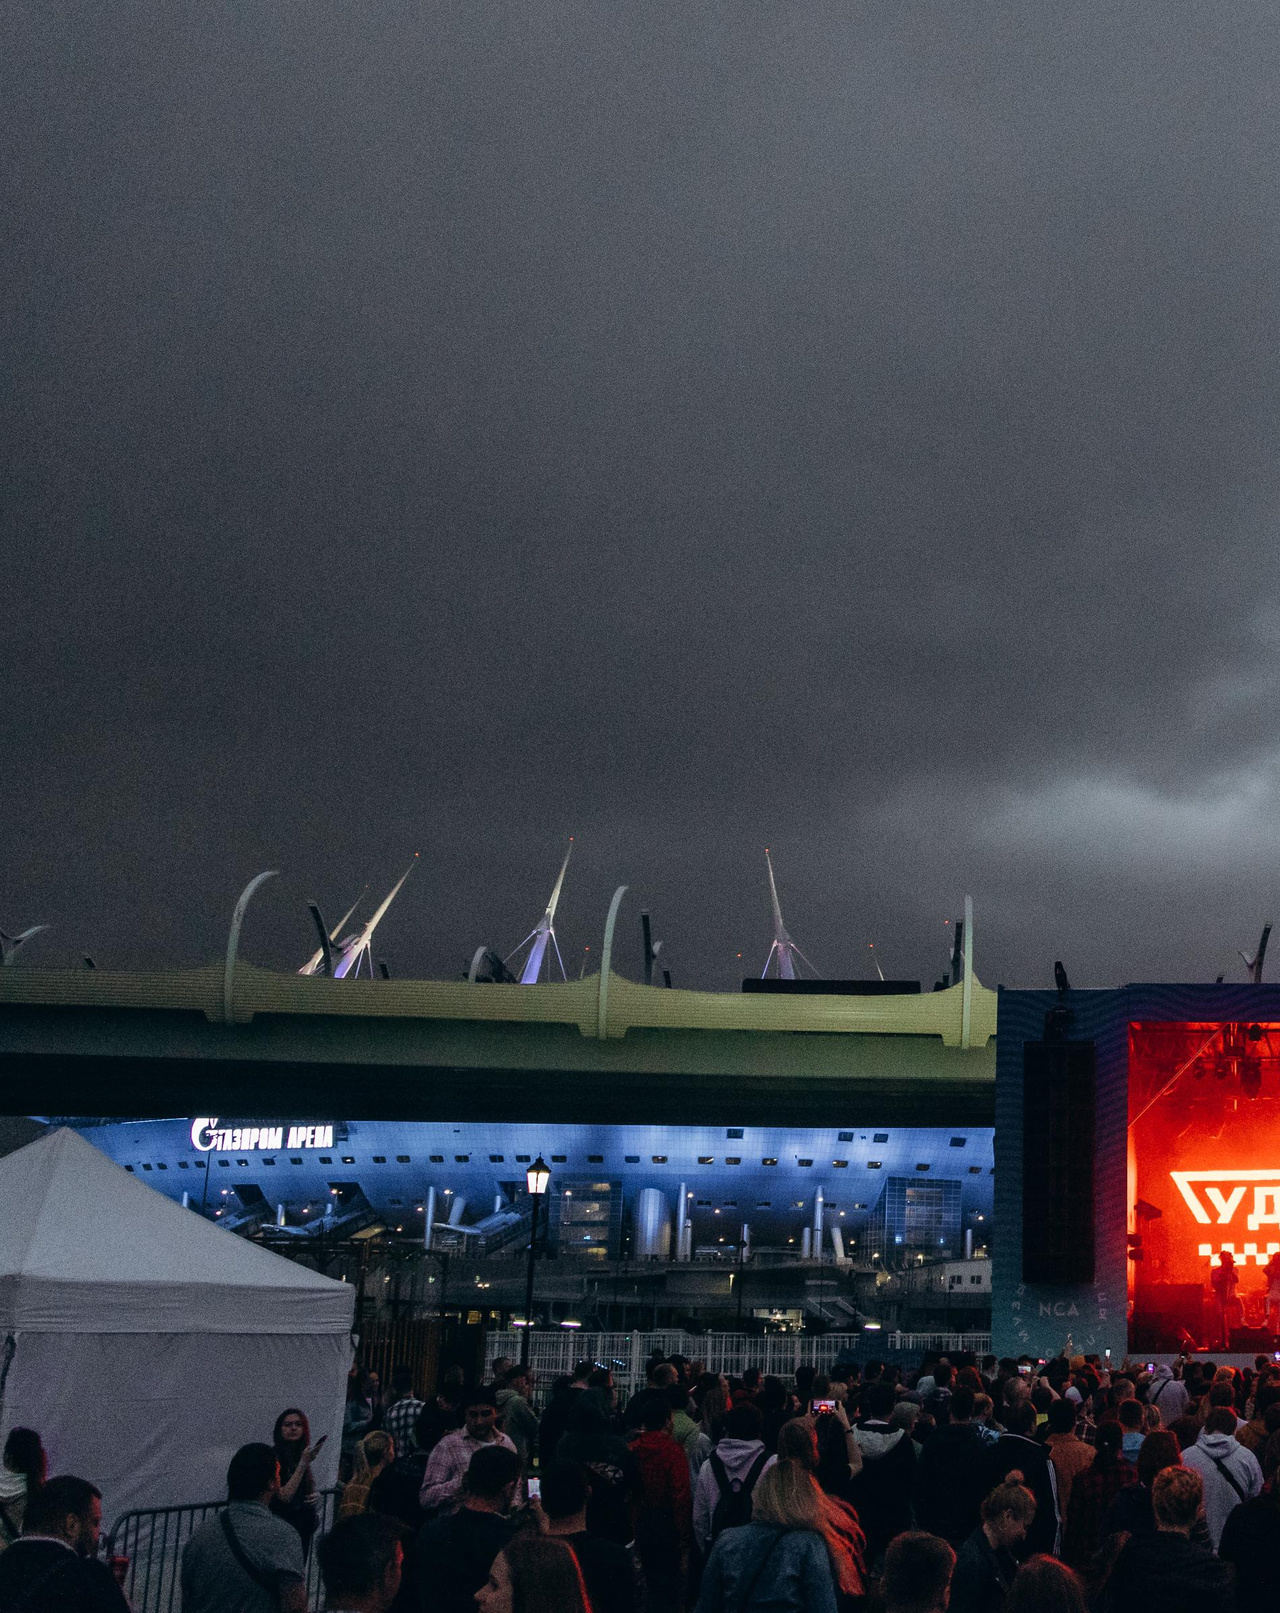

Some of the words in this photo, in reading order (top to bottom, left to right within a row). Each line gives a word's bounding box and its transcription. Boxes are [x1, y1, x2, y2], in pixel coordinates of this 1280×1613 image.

[192, 1118, 283, 1151] ГАЗПРОМ
[286, 1126, 333, 1149] АРЕНА
[1039, 1301, 1080, 1317] NCA
